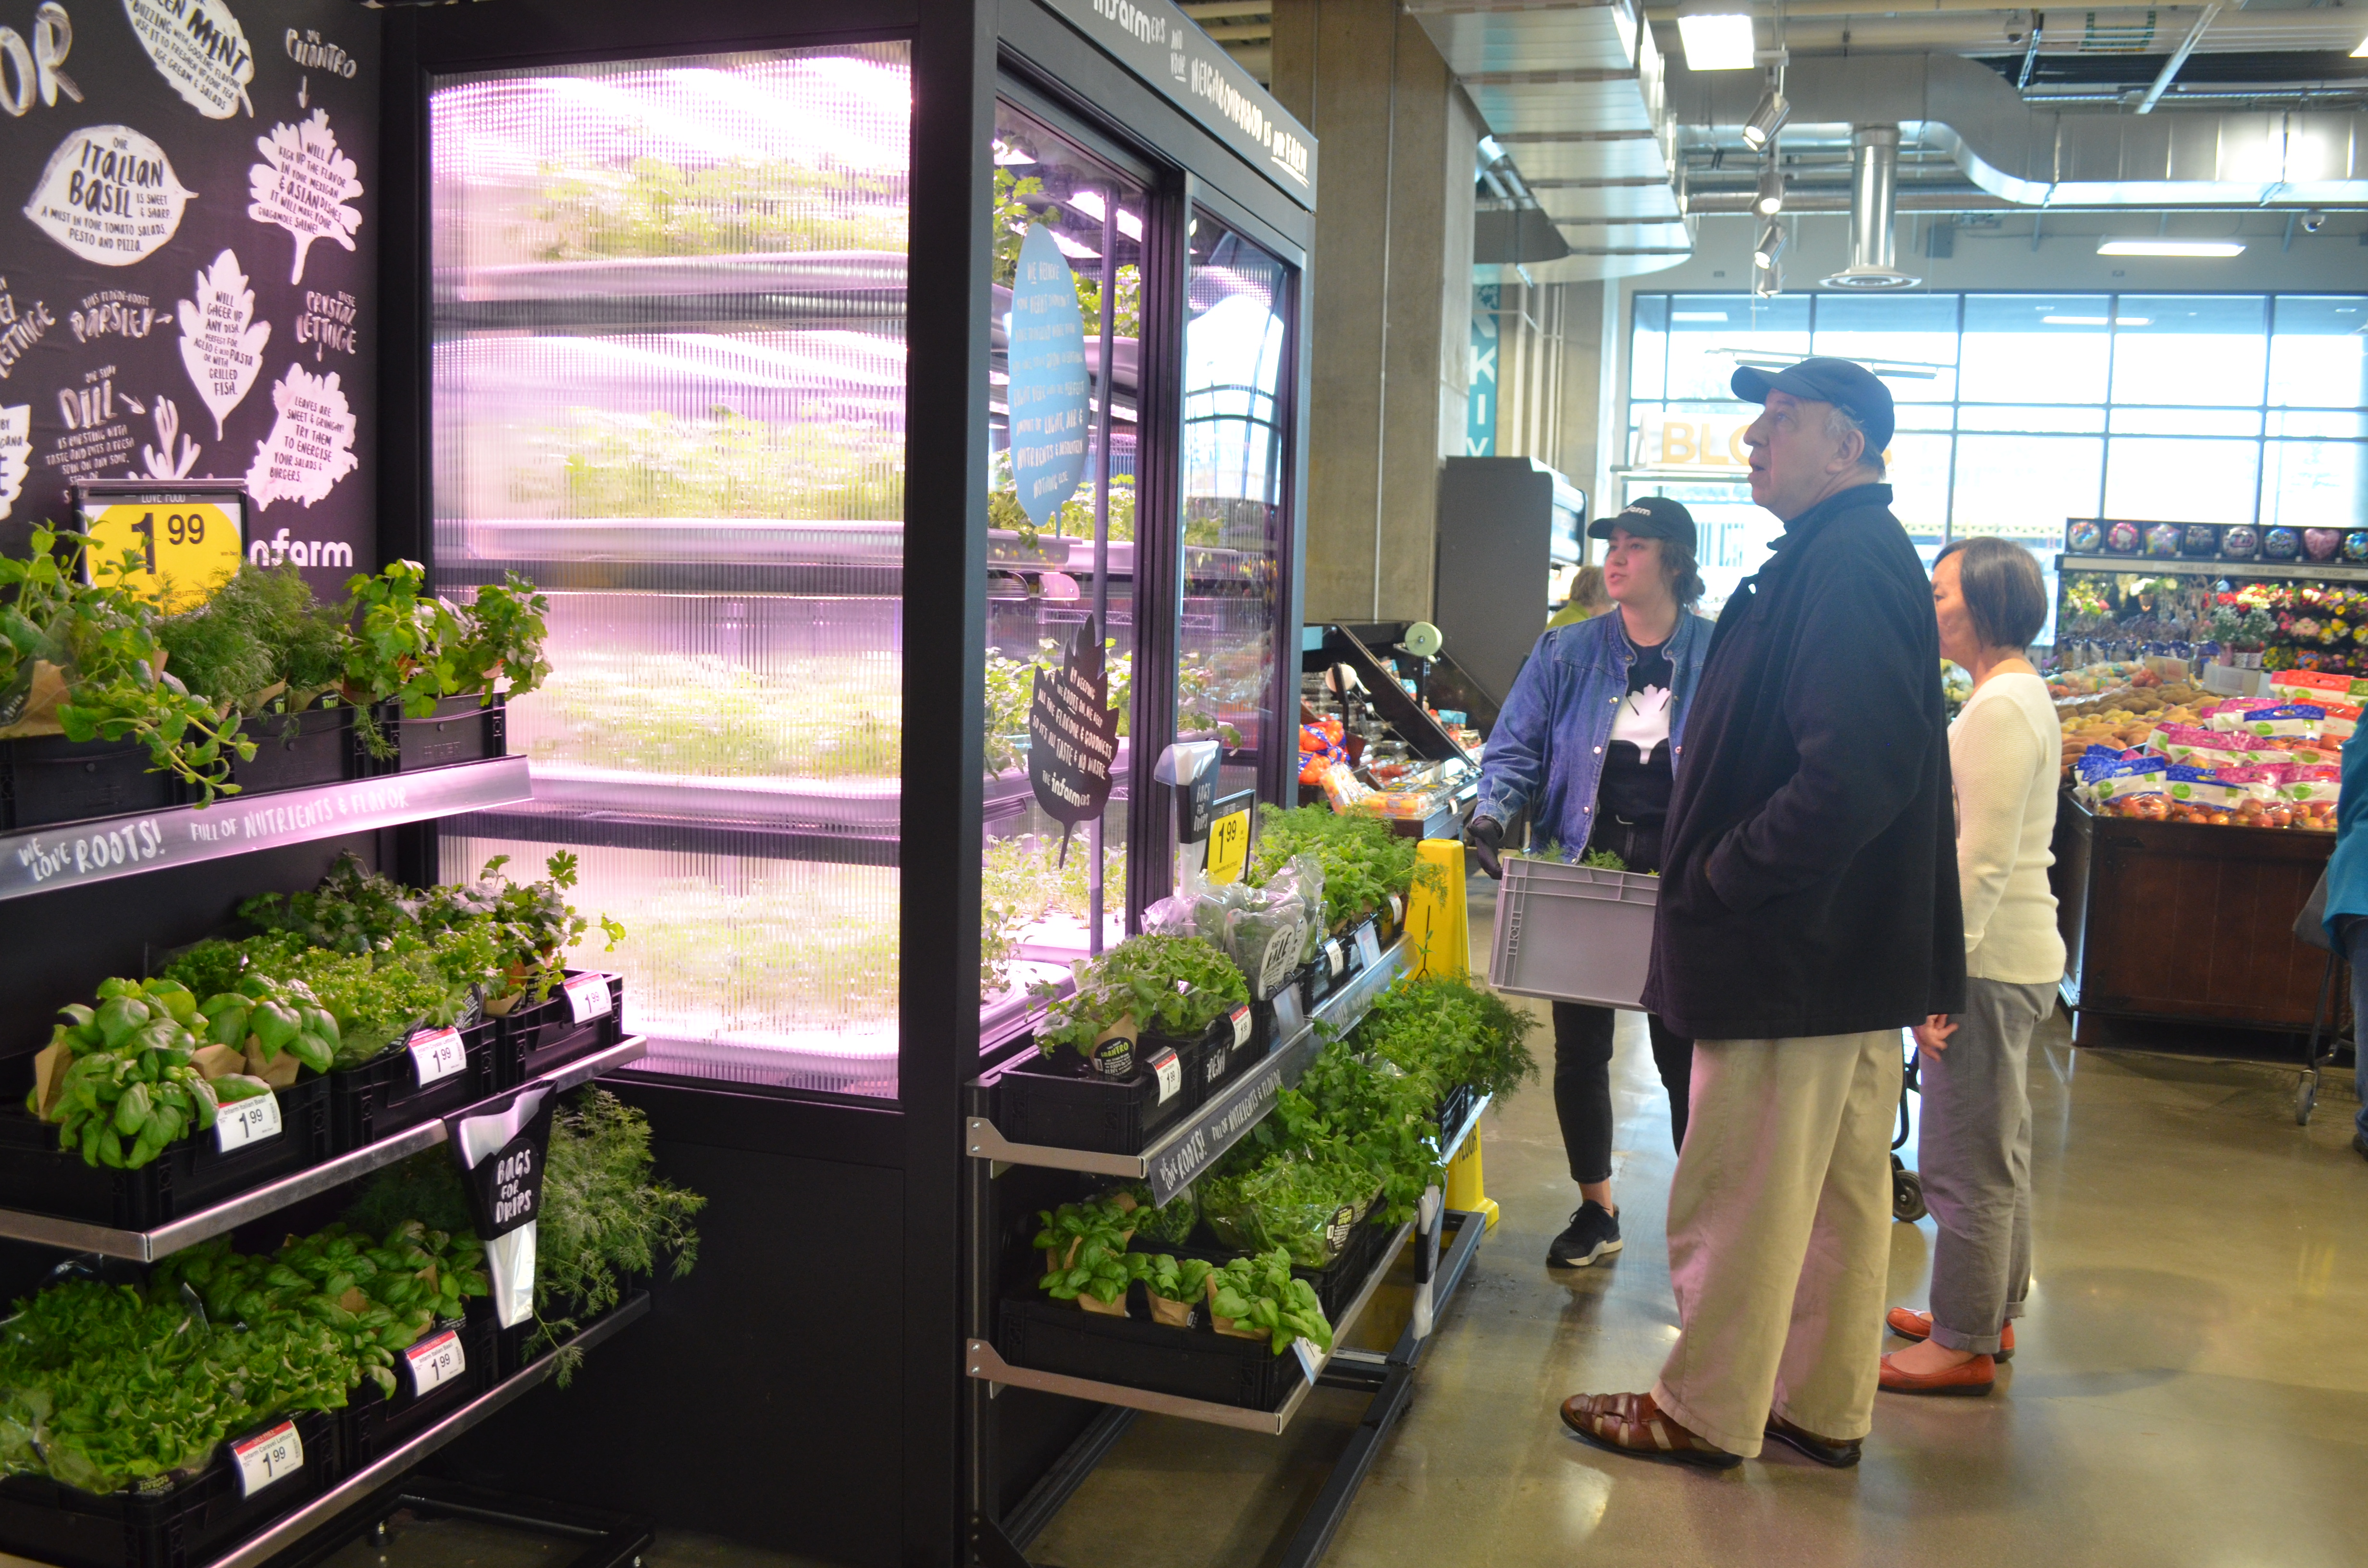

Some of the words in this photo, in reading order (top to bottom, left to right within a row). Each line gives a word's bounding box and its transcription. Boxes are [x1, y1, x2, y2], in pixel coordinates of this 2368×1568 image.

[133, 2, 172, 34] BUZZING
[135, 18, 149, 34] USE
[149, 27, 160, 43] IT
[160, 36, 169, 48] TO
[171, 42, 198, 71] FRESHEN
[198, 67, 207, 78] UP
[205, 73, 222, 91] YOUR
[187, 8, 249, 76] MINT
[285, 28, 357, 79] CILANTRO
[193, 78, 199, 89] &
[199, 84, 227, 110] SALADS
[1191, 57, 1263, 142] NEIGHBOURHOOD
[1263, 121, 1272, 147] IS
[1285, 133, 1307, 177] FARM
[113, 137, 128, 150] OUR
[307, 142, 325, 161] WILL
[81, 139, 164, 188] ITALIAN
[281, 161, 290, 175] IN
[292, 169, 307, 184] YOUR
[296, 151, 306, 165] UP
[307, 160, 320, 175] THE
[321, 167, 346, 188] FLAVOR
[68, 170, 133, 216] BASIL
[136, 193, 145, 204] IS
[146, 194, 168, 205] SWEET
[279, 175, 285, 191] &
[287, 181, 320, 210] ASIAN
[41, 206, 48, 217] A
[50, 208, 71, 223] MUST
[73, 216, 82, 227] IN
[84, 219, 102, 232] YOUR
[104, 222, 135, 235] TOMATO
[139, 207, 146, 217] &
[270, 189, 280, 203] IT
[280, 196, 297, 214] WILL
[298, 205, 313, 219] MAKE
[314, 212, 332, 231] YOUR
[69, 228, 96, 245] PESTO
[98, 237, 114, 249] AND
[294, 217, 319, 235] SHINE!
[216, 291, 234, 307] WILL
[306, 290, 358, 327] CRYSTAL
[70, 302, 157, 343] PARSLEY
[207, 304, 232, 321] CHEER
[234, 311, 244, 322] UP
[205, 320, 221, 334] ANY
[205, 333, 226, 345] PERFECT
[226, 338, 238, 348] FOR
[296, 312, 357, 355] LETTUCE
[193, 337, 213, 354] AGLIO
[229, 351, 254, 368] PASTA
[203, 353, 211, 362] OR
[212, 356, 229, 368] WITH
[209, 367, 238, 380] GRILLED
[58, 379, 118, 430] DILL
[286, 408, 308, 423] SWEET
[309, 414, 315, 424] &
[295, 396, 318, 413] LEAVES
[319, 405, 332, 417] ARE
[1079, 408, 1083, 425] &
[57, 436, 67, 450] IS
[107, 424, 128, 438] WITH
[296, 424, 309, 437] TRY
[312, 430, 333, 447] THEM
[46, 452, 69, 466] TASTE
[70, 449, 87, 460] AND
[87, 443, 104, 457] PUTS
[106, 442, 112, 452] A
[112, 438, 135, 451] FRESH
[81, 460, 92, 470] ON
[94, 455, 108, 468] ANY
[274, 451, 294, 467] YOUR
[294, 456, 318, 471] SALADS
[318, 462, 323, 471] &
[284, 436, 295, 449] TO
[296, 441, 333, 463] ENERGISE
[1017, 444, 1054, 471] NUTRIENTS
[1034, 473, 1058, 499] NOTHING
[131, 512, 157, 575] 1
[168, 514, 205, 545] 99
[1070, 666, 1078, 685] BY
[1063, 686, 1079, 712] ROOTS
[1037, 687, 1046, 706] ALL
[1046, 696, 1056, 717] THE
[1055, 708, 1079, 740] FLAVOUR
[1080, 726, 1085, 742] &
[1032, 714, 1040, 729] SO
[1048, 731, 1057, 749] ALL
[1056, 737, 1073, 767] TASTE
[1073, 749, 1078, 763] &
[1042, 769, 1051, 786] THE
[190, 822, 220, 842] FULL
[221, 818, 239, 837] OF
[244, 797, 334, 839] NUTRIENTS
[338, 797, 348, 815] &
[350, 786, 410, 814] FLAVOR
[18, 837, 44, 867] WE
[32, 842, 72, 882] LOVE
[75, 818, 166, 873] ROOTS!
[1218, 822, 1225, 864] 1
[1226, 820, 1237, 843] 99
[584, 993, 592, 1014] 1
[591, 992, 600, 1003] 99
[432, 1050, 441, 1073] 1
[441, 1047, 451, 1060] 99
[239, 1101, 254, 1110] Italian
[253, 1096, 267, 1105] Basil
[1211, 1126, 1223, 1141] FULL
[1221, 1117, 1229, 1134] OF
[1228, 1089, 1259, 1132] NUTRIENTS
[1258, 1086, 1263, 1101] &
[239, 1112, 250, 1139] 1
[249, 1108, 263, 1124] 99
[497, 1149, 531, 1185] BAGS
[1159, 1157, 1169, 1181] WE
[1165, 1158, 1178, 1191] LOVE
[1177, 1128, 1207, 1180] ROOTS!
[501, 1179, 519, 1200] FOR
[495, 1189, 532, 1224] DRIPS
[443, 1342, 453, 1351] Basil
[431, 1358, 440, 1381] 1
[439, 1353, 451, 1368] 99
[259, 1439, 277, 1453] Caravel
[276, 1432, 294, 1444] Lettuce
[262, 1452, 273, 1478] 1
[272, 1446, 286, 1462] 99
